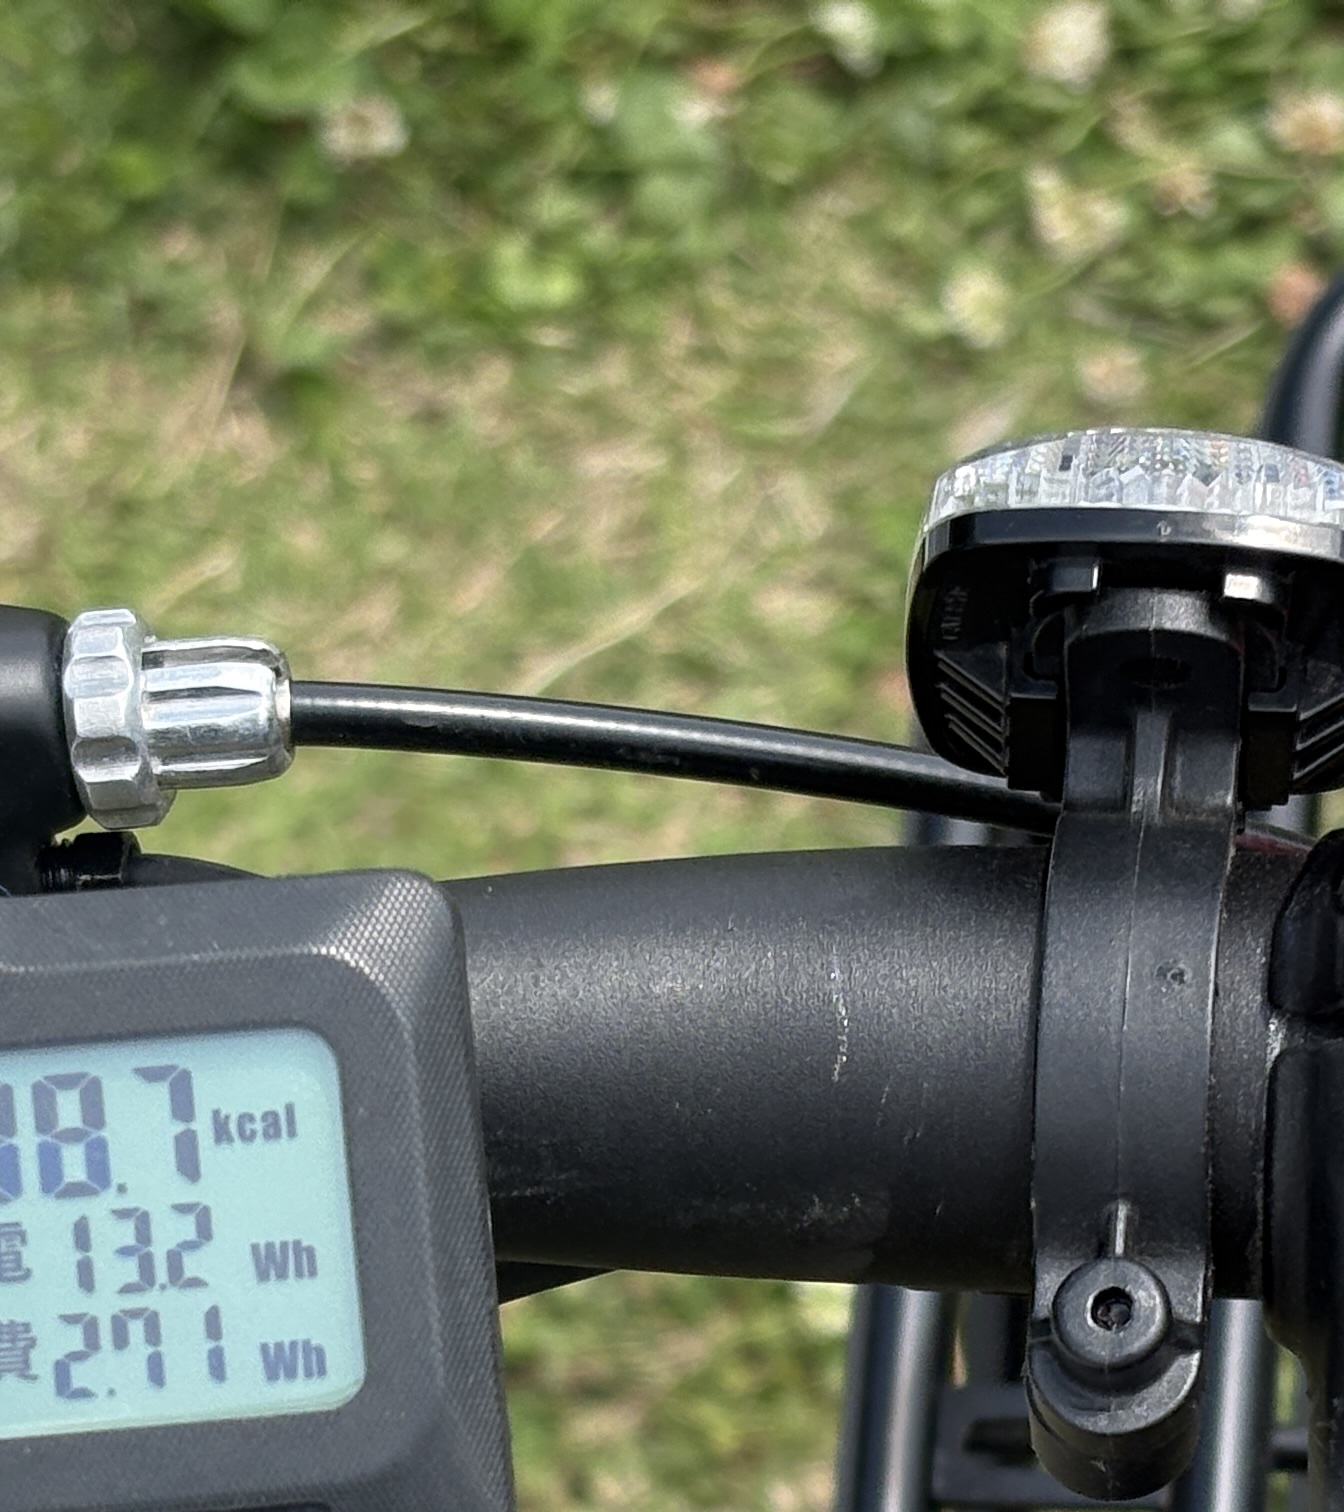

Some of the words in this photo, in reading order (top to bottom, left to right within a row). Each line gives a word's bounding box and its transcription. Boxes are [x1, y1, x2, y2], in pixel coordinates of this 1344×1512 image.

[210, 1103, 298, 1147] kcal
[73, 1202, 213, 1295] 13.2
[251, 1239, 318, 1284] Wh
[54, 1304, 226, 1400] 2.71
[259, 1338, 327, 1383] Wh
